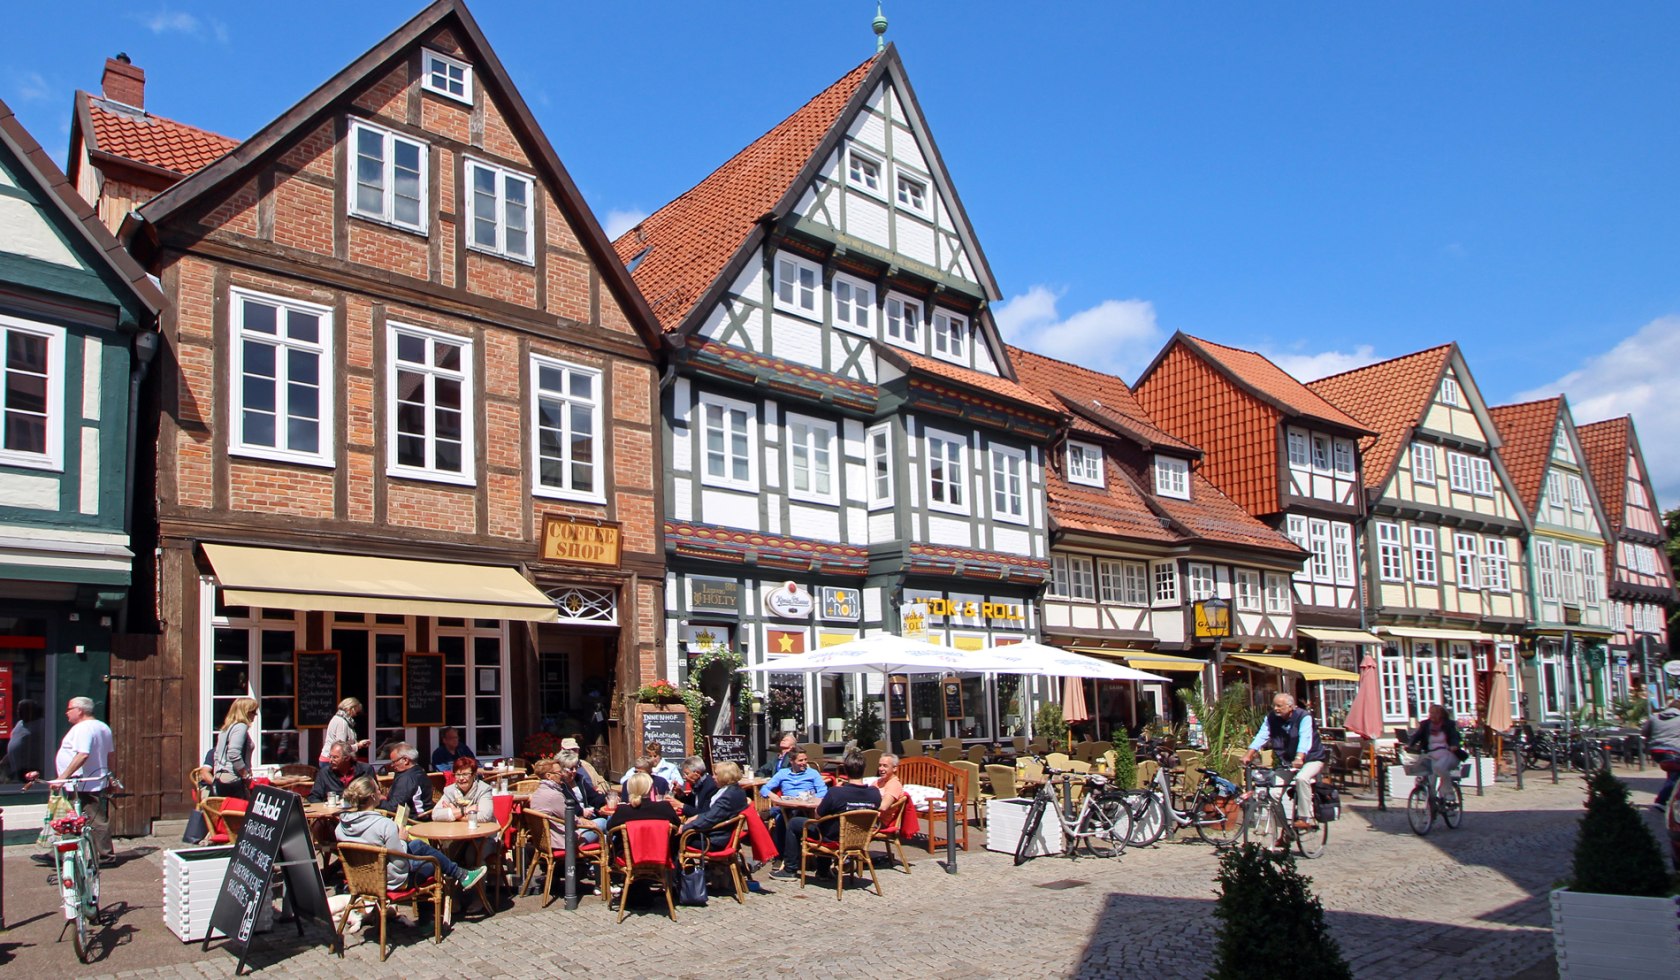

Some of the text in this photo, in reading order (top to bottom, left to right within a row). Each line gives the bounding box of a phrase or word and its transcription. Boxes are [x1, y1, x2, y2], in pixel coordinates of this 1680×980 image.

[549, 522, 614, 545] COFFEE
[556, 541, 605, 560] SHOP
[826, 590, 856, 604] WOK
[903, 611, 917, 621] Wok
[964, 600, 977, 618] &
[981, 602, 1025, 620] ROLL
[902, 621, 926, 631] ROLL
